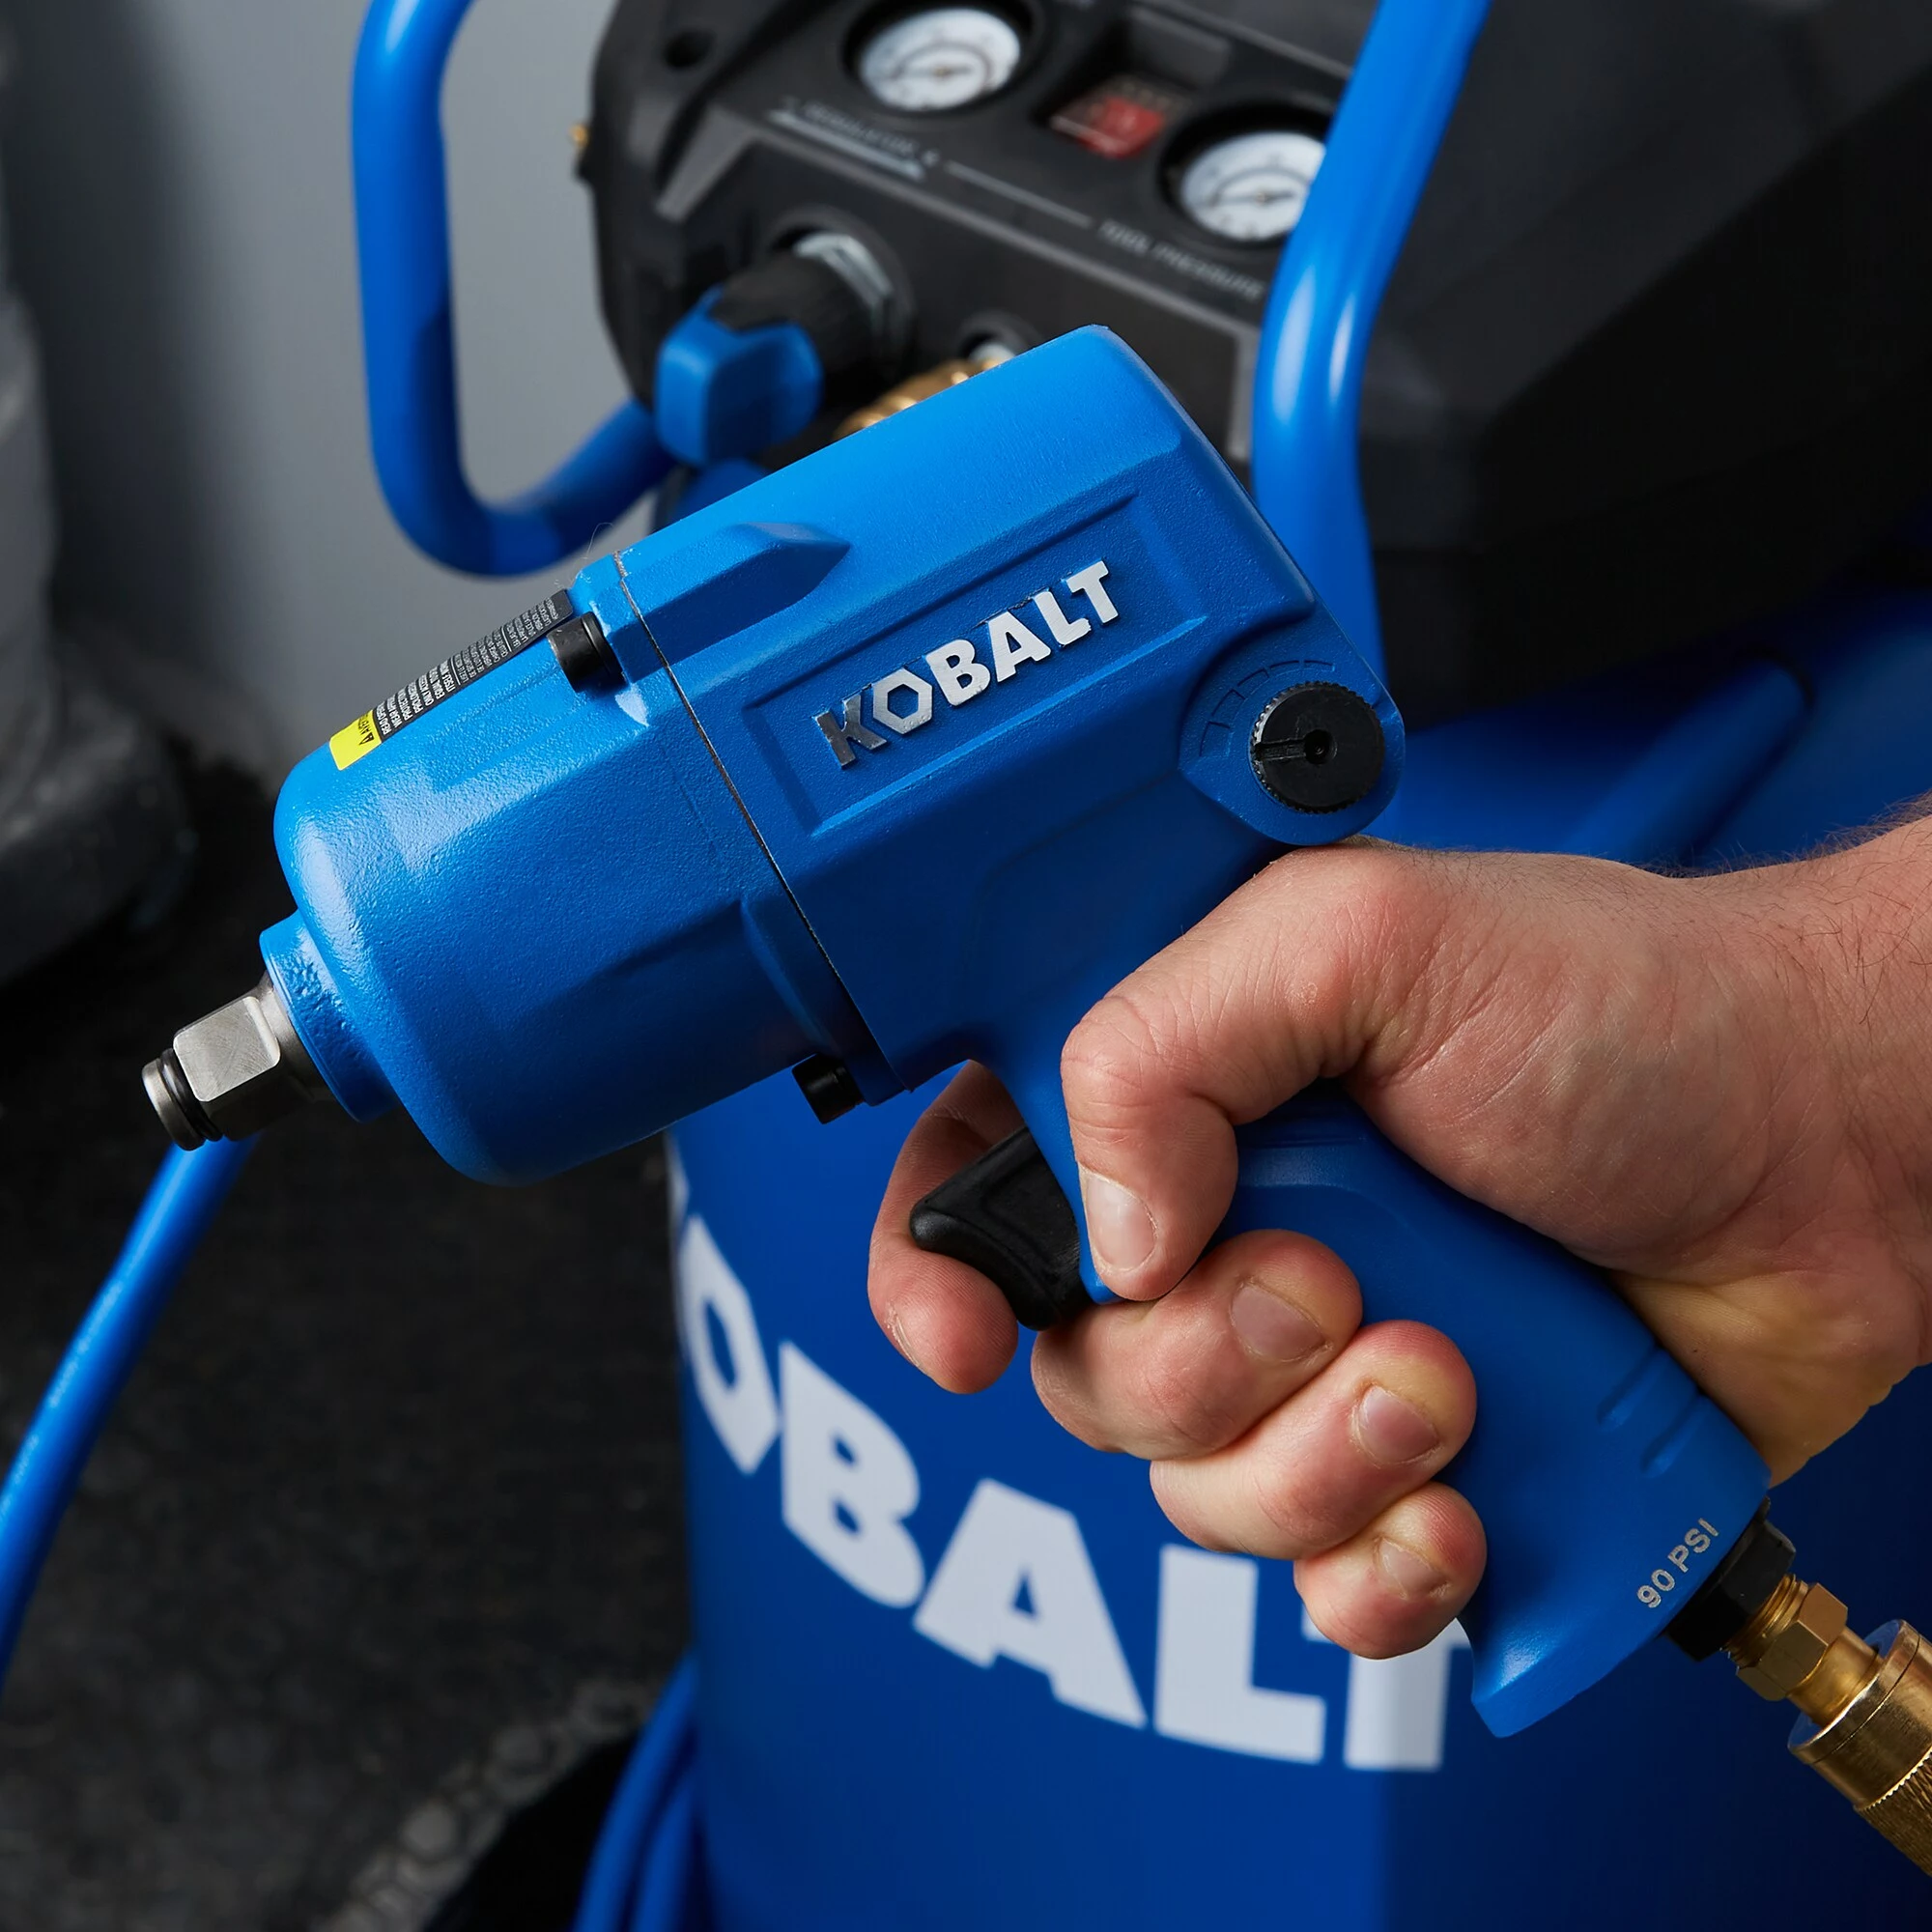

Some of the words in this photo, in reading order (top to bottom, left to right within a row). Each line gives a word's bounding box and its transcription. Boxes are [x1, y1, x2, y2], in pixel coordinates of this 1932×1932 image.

[813, 560, 1119, 768] KOBALT
[420, 687, 435, 707] ONLY
[430, 678, 445, 699] EQUAL
[378, 716, 392, 735] READ
[387, 708, 403, 728] WEAR
[1636, 1569, 1676, 1608] 90
[1667, 1518, 1719, 1573] PSI
